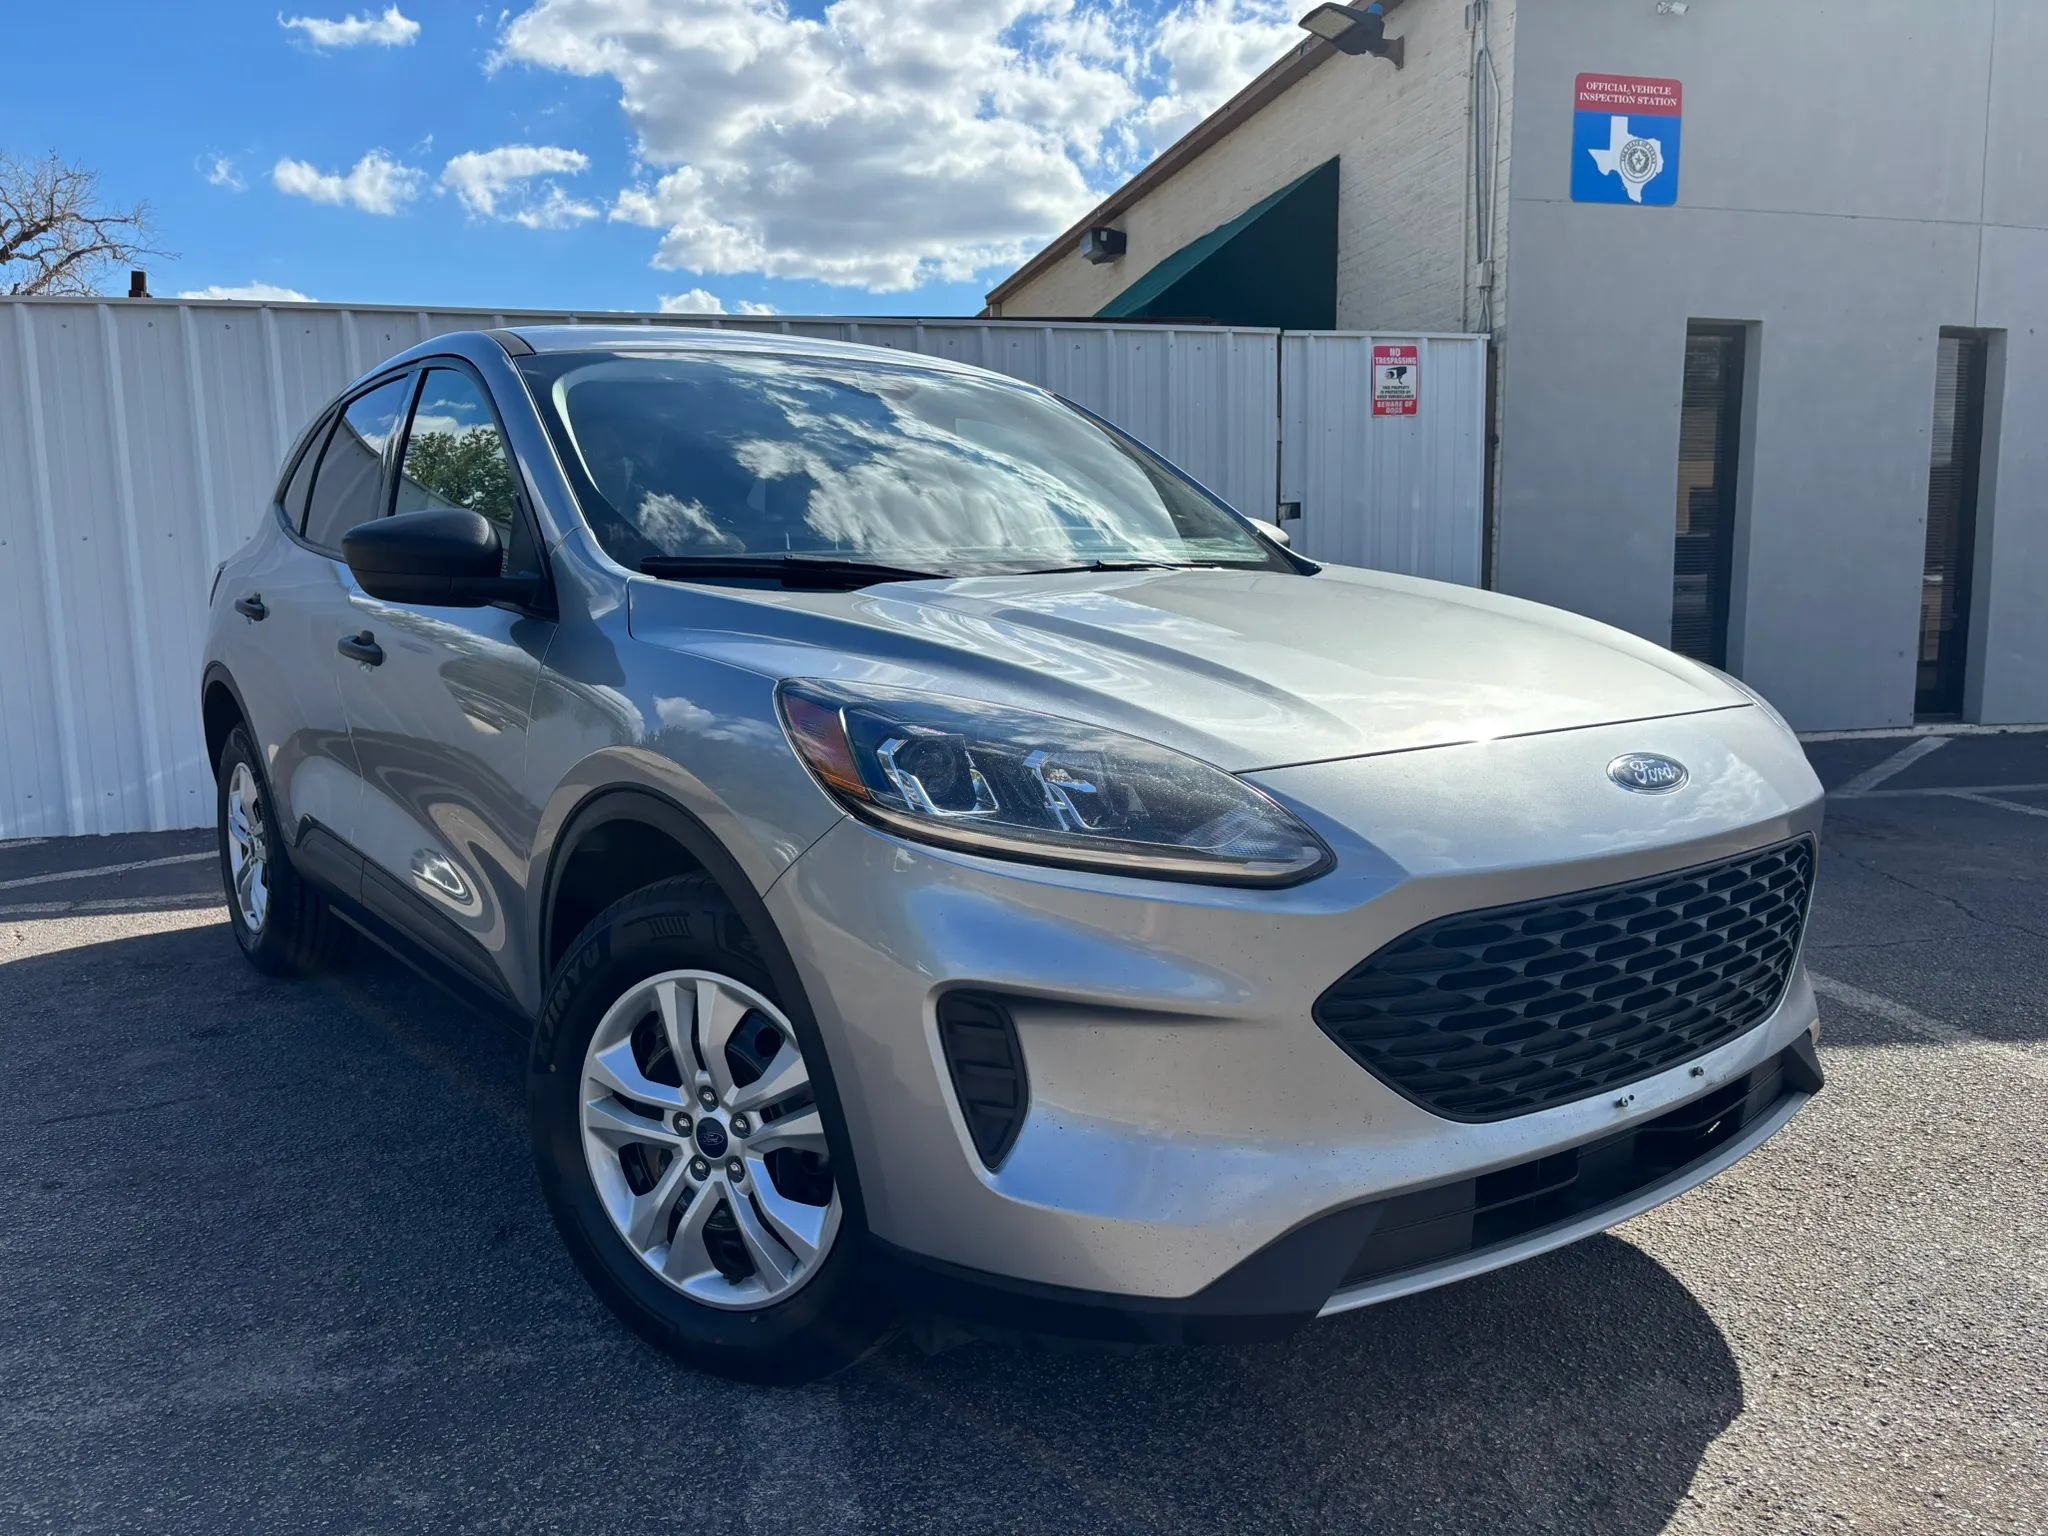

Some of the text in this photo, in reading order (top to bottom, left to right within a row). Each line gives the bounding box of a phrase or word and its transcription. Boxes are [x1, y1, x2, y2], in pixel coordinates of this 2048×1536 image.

[1586, 81, 1672, 95] OFFICIAL VEHICLE
[1580, 92, 1677, 106] INSPECTION STATION
[1390, 347, 1401, 357] NO
[1375, 357, 1417, 365] TRESPASSING
[1377, 400, 1403, 408] BEWARE
[1629, 758, 1676, 785] Ford
